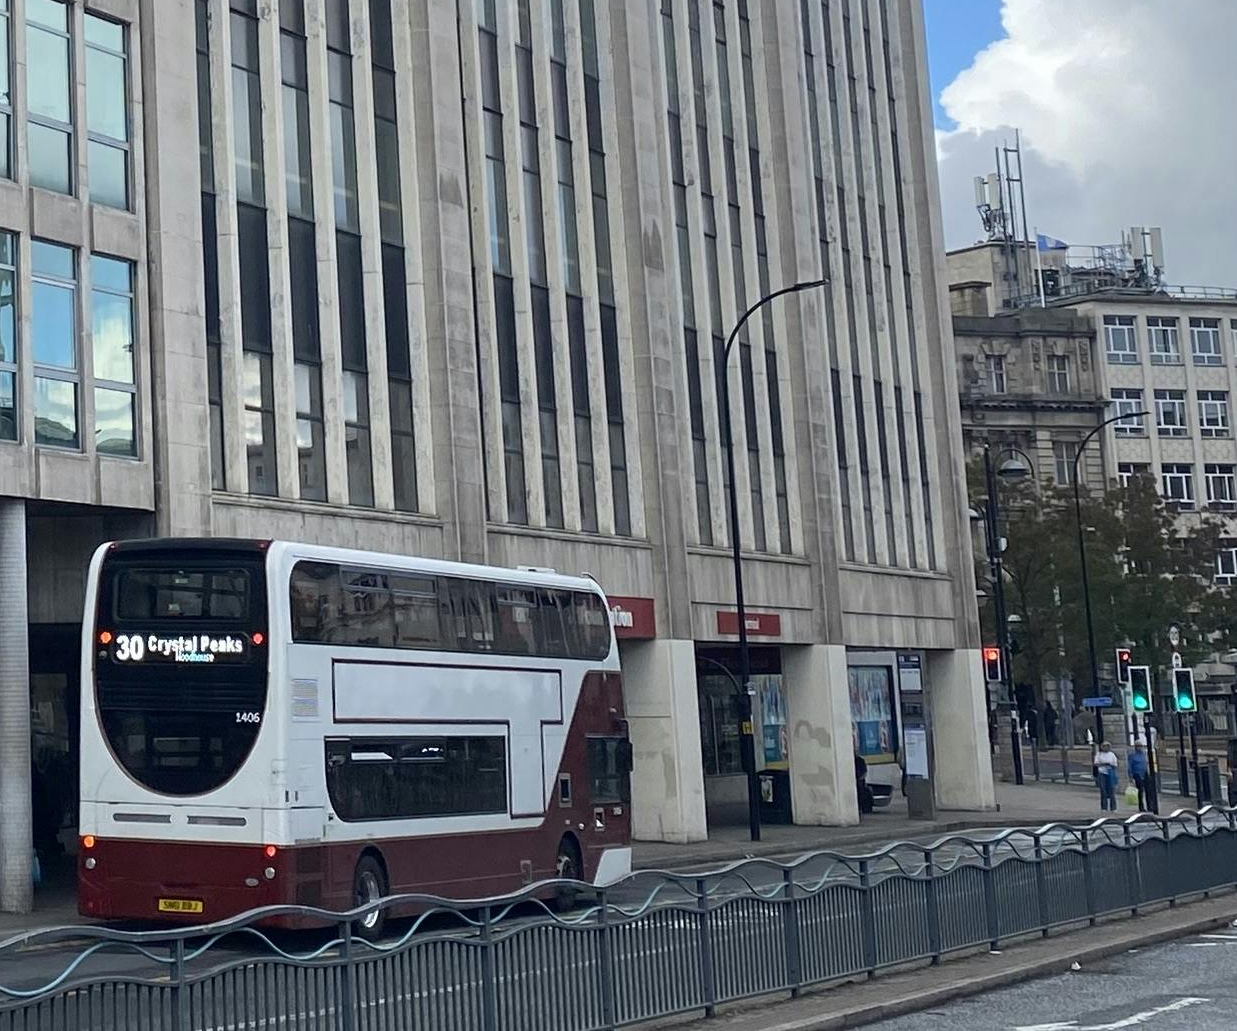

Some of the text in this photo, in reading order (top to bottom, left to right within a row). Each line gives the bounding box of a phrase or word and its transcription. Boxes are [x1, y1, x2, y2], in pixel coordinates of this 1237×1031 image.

[116, 634, 243, 661] 30 Crystal Peaks
[235, 711, 261, 723] 1406
